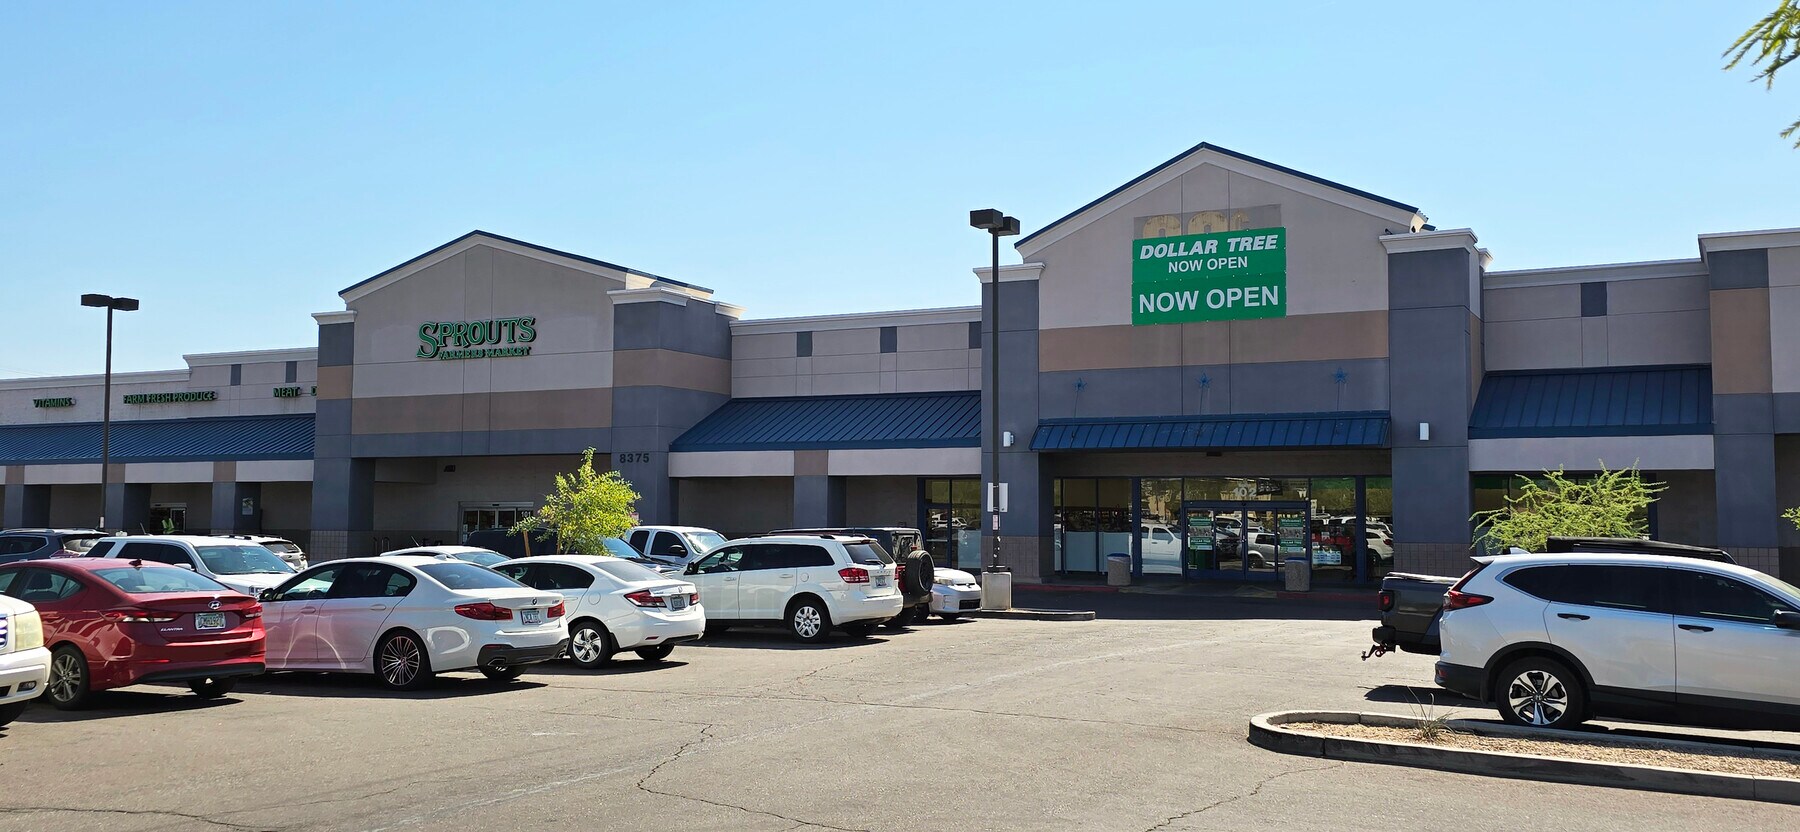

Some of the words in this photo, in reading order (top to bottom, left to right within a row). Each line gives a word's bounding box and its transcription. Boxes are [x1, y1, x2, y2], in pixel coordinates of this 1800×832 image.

[1139, 239, 1219, 260] DOLLAR
[1226, 234, 1279, 252] TREE
[1168, 259, 1204, 274] NOW
[1206, 256, 1249, 271] OPEN
[1139, 290, 1200, 314] NOW
[1206, 285, 1279, 310] OPEN
[416, 316, 536, 359] SPROUTS
[486, 345, 531, 357] MARKET
[148, 391, 172, 403] FRESH
[173, 387, 216, 402] PRODUCE
[272, 387, 300, 398] MEAT
[33, 398, 73, 408] VITAMINS
[619, 452, 650, 463] 8375
[1233, 487, 1257, 497] 102
